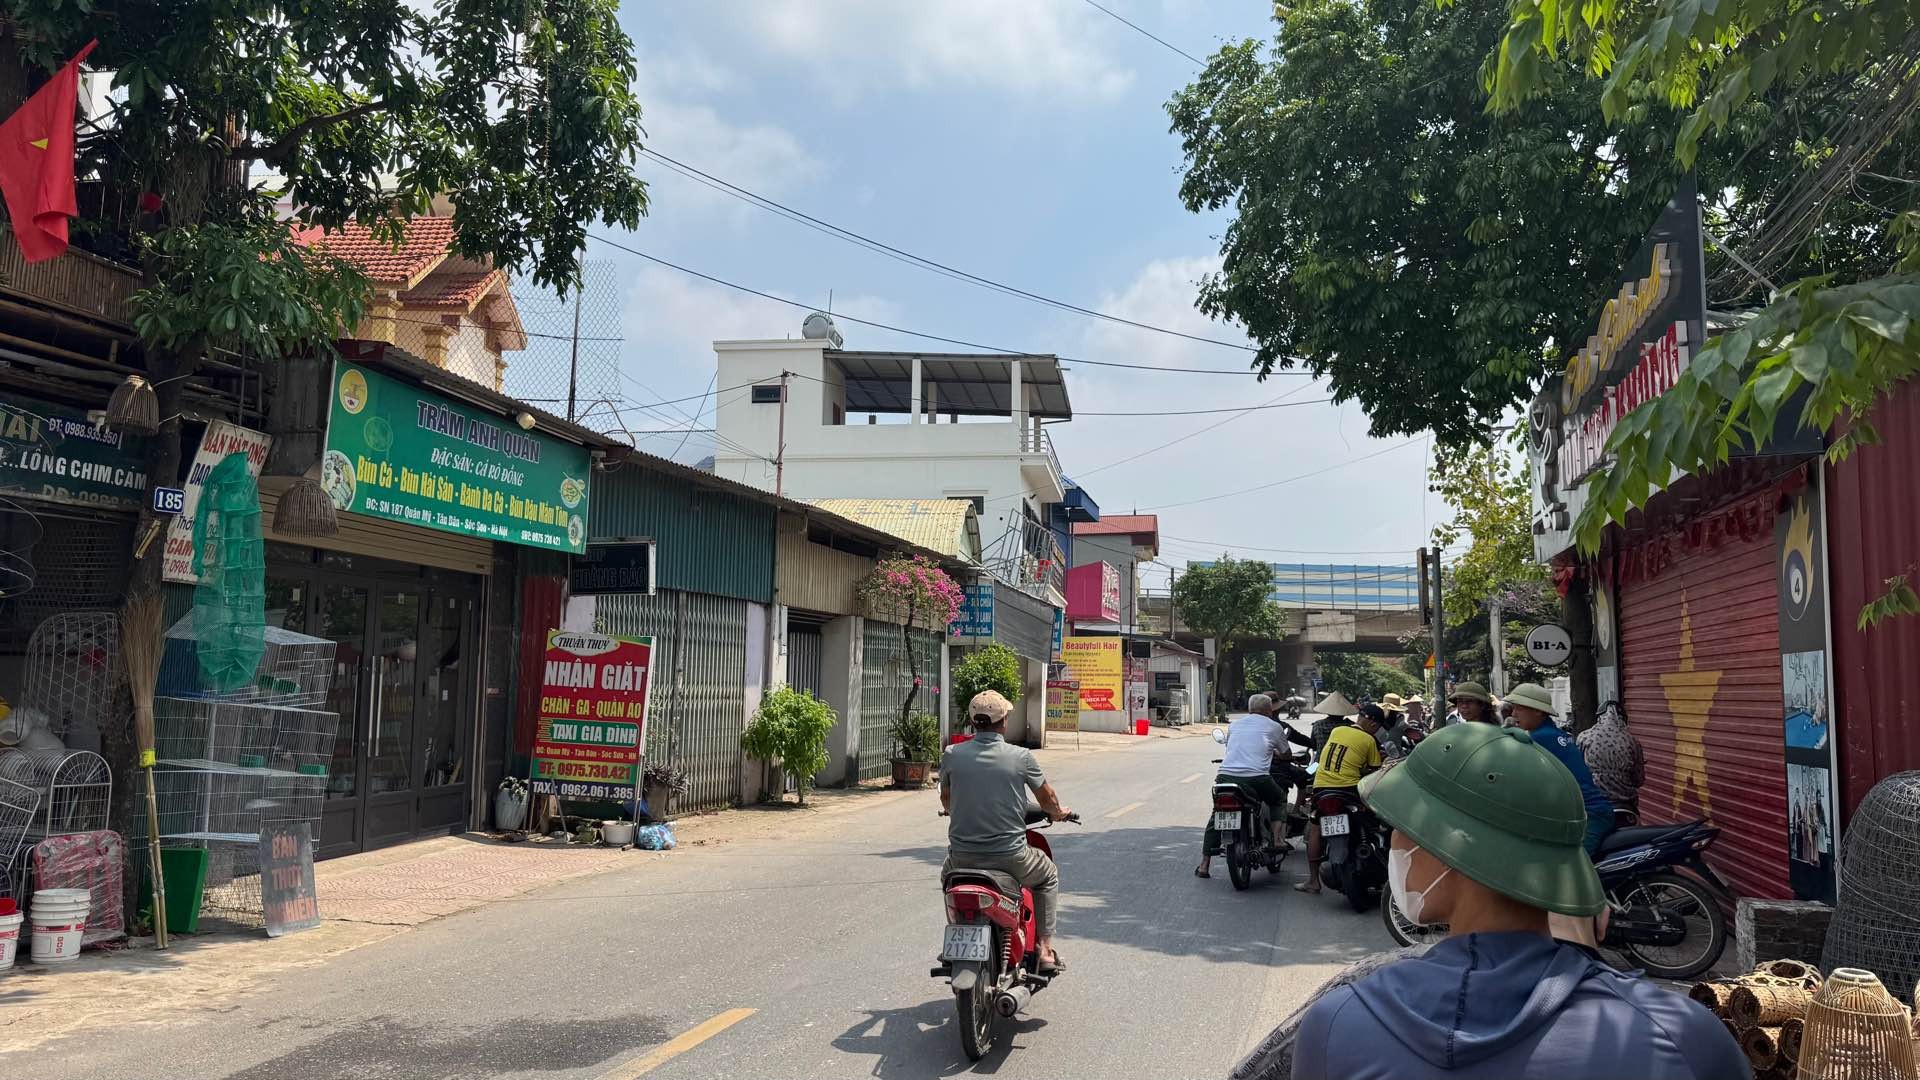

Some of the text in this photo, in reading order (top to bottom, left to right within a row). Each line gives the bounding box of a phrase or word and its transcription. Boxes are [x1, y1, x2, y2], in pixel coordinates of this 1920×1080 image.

[416, 399, 541, 465] TRÂM ANH QUÁN
[203, 426, 230, 455] BÁN
[248, 441, 268, 466] ONG
[431, 447, 453, 469] ĐẶC
[357, 455, 378, 485] Bún
[380, 461, 393, 489] Cá
[400, 466, 420, 495] Bún
[420, 472, 436, 499] Hải
[437, 475, 454, 503] Sản
[460, 482, 481, 510] Bánh
[493, 489, 504, 515] Cá
[509, 494, 524, 519] Bún
[157, 490, 183, 511] 185
[379, 500, 390, 513] SN
[391, 503, 404, 516] 187
[1793, 581, 1802, 597] 4
[558, 636, 586, 651] THUẬN
[1103, 641, 1119, 651] Hair
[1532, 640, 1567, 651] BI-A
[544, 658, 647, 696] NHẬN GIẶT
[576, 701, 590, 716] GA
[627, 700, 642, 719] ÁO
[552, 723, 638, 744] TAXI GIA ĐÌNH
[1324, 743, 1348, 773] 11
[557, 762, 631, 780] 0975.738.421
[561, 783, 634, 800] 0962.061.385
[950, 927, 984, 943] 29-Z1
[945, 943, 987, 959] 217.33
